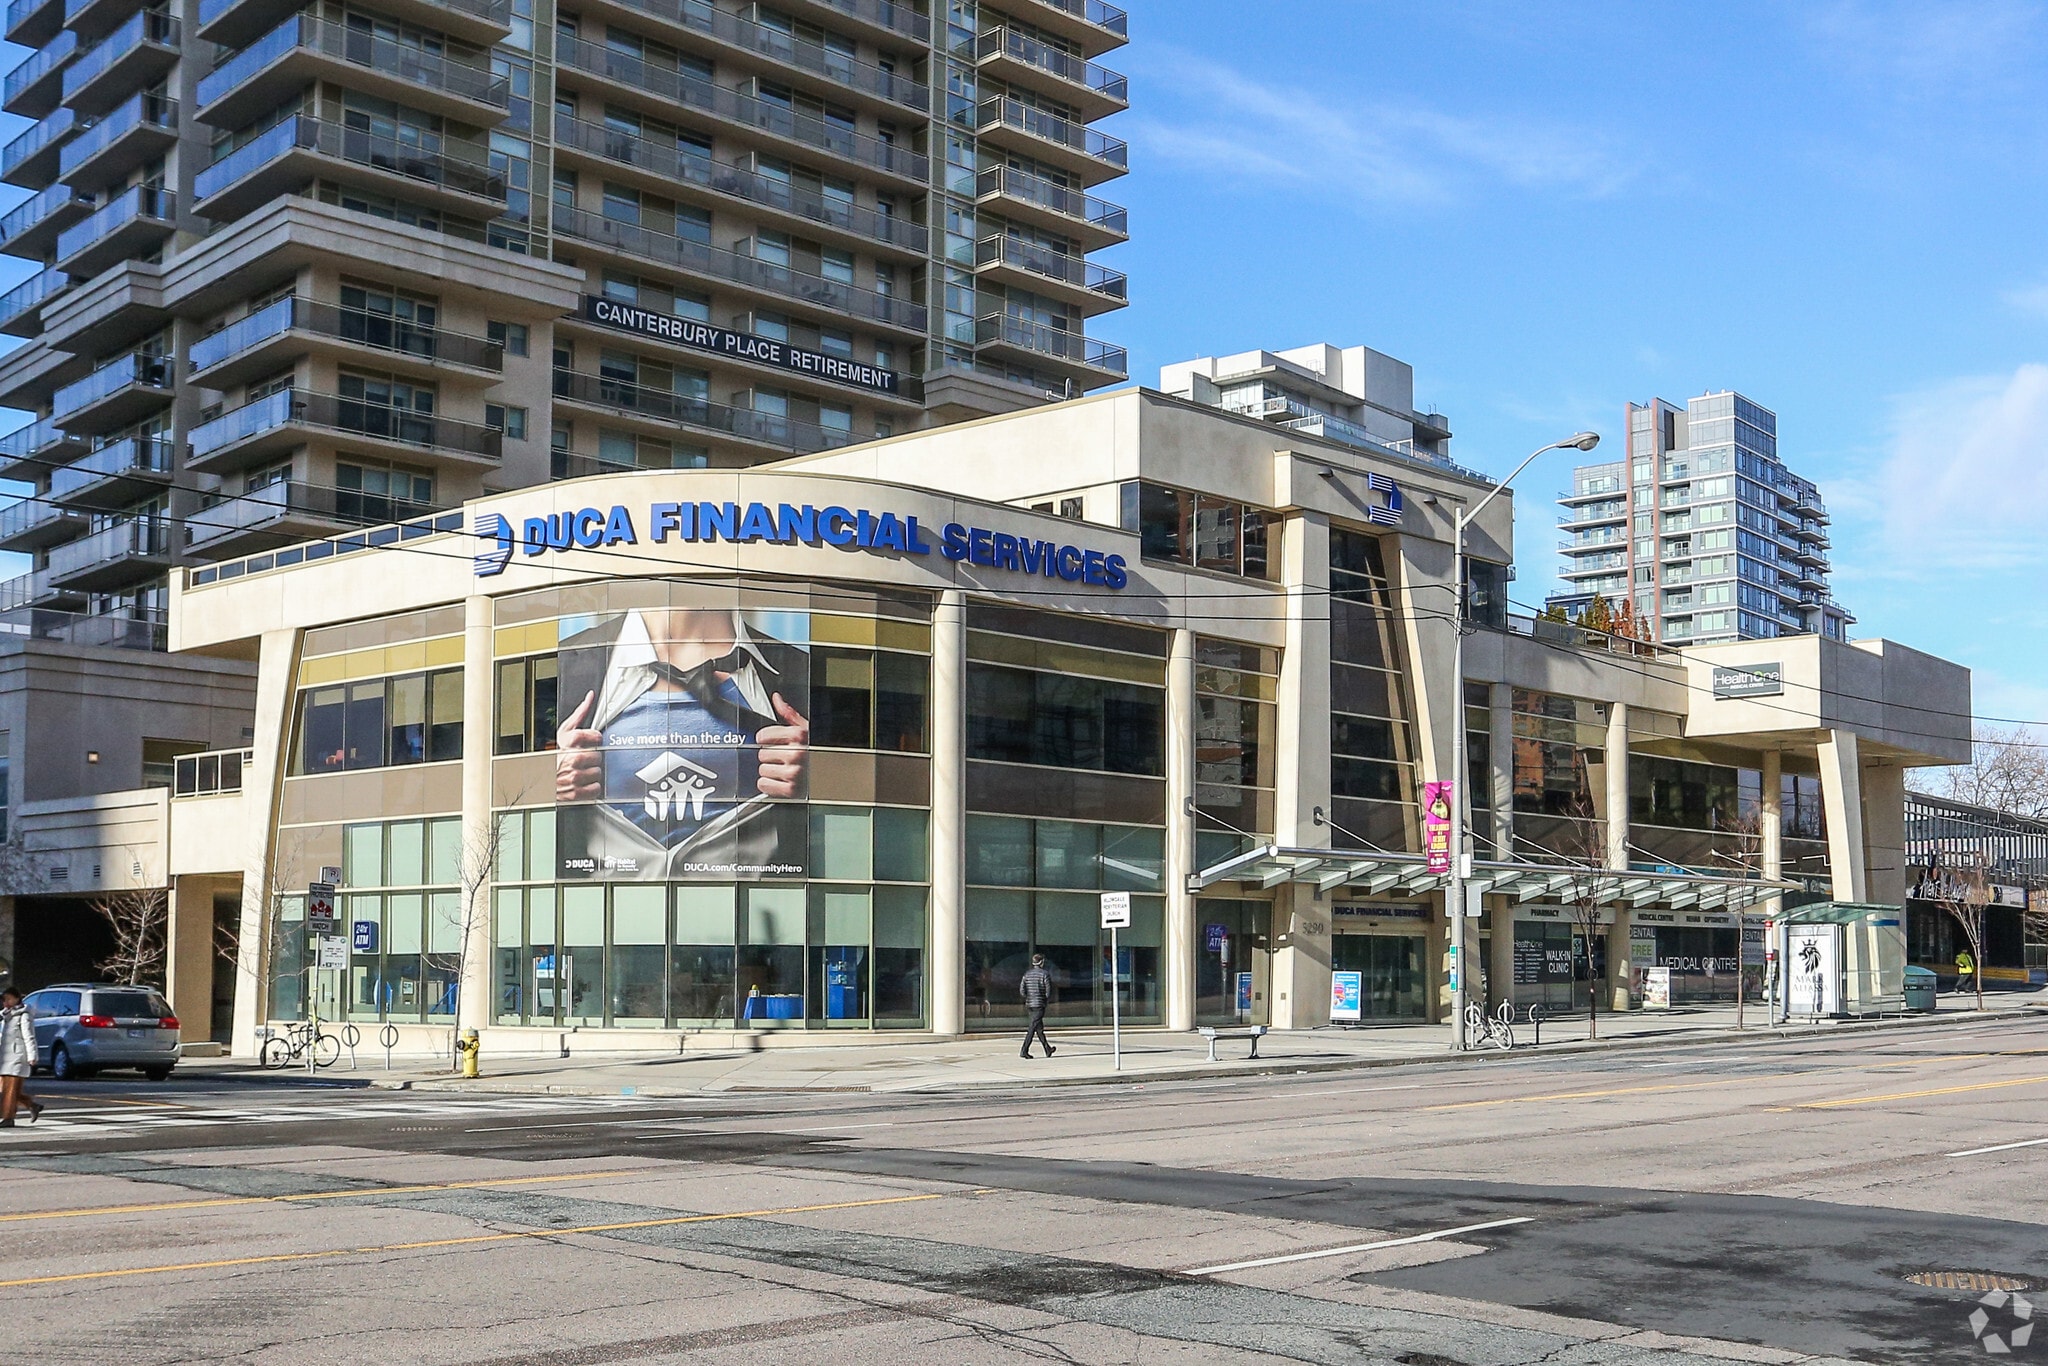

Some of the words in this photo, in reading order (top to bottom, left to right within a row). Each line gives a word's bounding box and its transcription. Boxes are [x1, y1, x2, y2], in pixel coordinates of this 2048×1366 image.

[596, 302, 719, 347] CANTERBURY
[726, 333, 780, 362] PLACE
[790, 350, 891, 388] RETIREMENT
[523, 505, 636, 556] DUCA
[651, 502, 930, 555] FINANCIAL
[940, 522, 1127, 590] SERVICES
[1714, 671, 1779, 685] HealthOne
[609, 734, 637, 746] Save
[637, 735, 668, 745] more
[670, 733, 697, 744] than
[701, 732, 720, 744] the
[723, 732, 746, 745] day
[572, 859, 595, 869] DUCA
[684, 863, 803, 874] DUCA.com/CommunityHero
[1334, 907, 1355, 915] DUCA
[1356, 908, 1393, 916] FINANCIAL
[1531, 909, 1559, 917] PHARMACY
[1629, 928, 1655, 938] DENTAL
[355, 935, 369, 945] ATM
[1546, 950, 1571, 960] WALK-IN
[1632, 945, 1652, 956] FREE
[1548, 963, 1569, 973] CLINIC
[1660, 957, 1699, 970] MEDICAL
[1702, 957, 1737, 970] CENTRE
